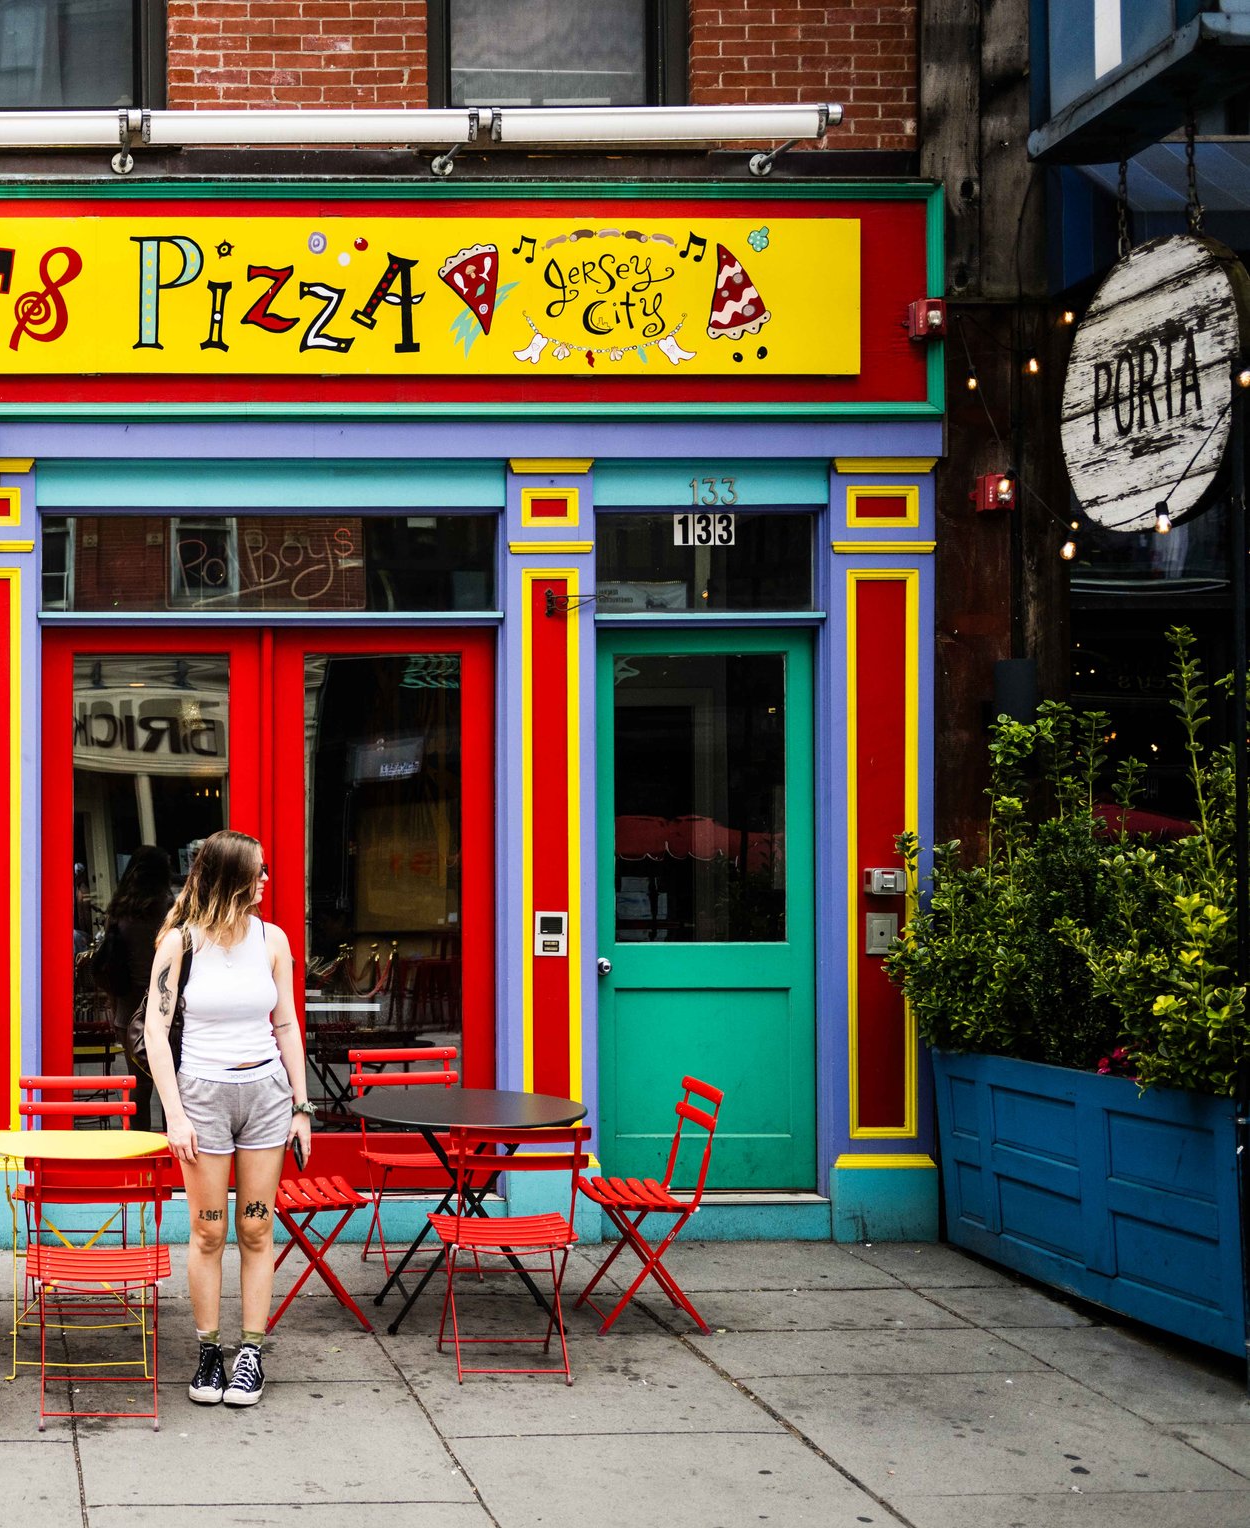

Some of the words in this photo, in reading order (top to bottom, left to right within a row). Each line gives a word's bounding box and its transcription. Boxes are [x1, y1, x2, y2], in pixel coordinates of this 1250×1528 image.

[582, 291, 665, 337] City
[1093, 327, 1202, 444] PORTA
[689, 478, 738, 505] 133
[678, 514, 733, 545] 133
[244, 528, 354, 600] Boys
